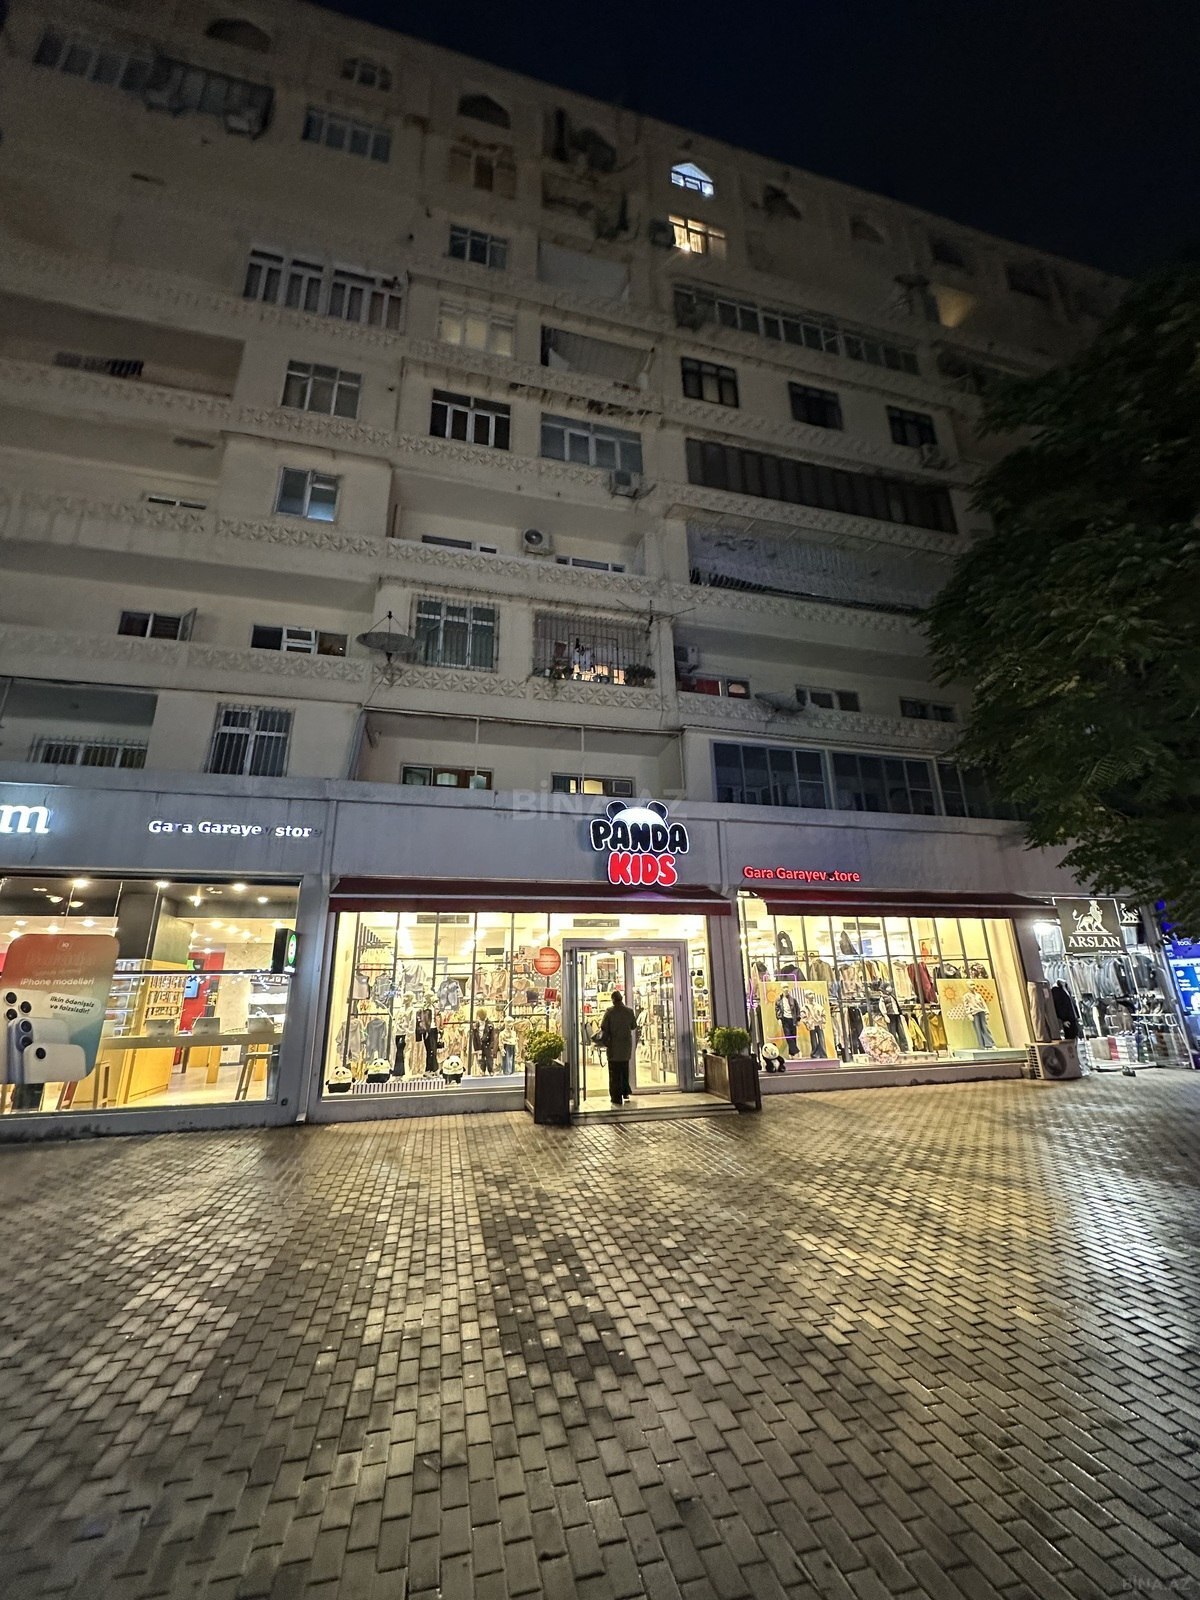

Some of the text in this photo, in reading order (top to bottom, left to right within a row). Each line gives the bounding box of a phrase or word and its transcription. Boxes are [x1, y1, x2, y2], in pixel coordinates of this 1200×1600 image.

[148, 820, 193, 833] Gara
[590, 819, 690, 854] PANDA
[608, 852, 678, 887] KIDS
[743, 866, 774, 879] Gara
[776, 867, 827, 882] Garayev
[1068, 936, 1121, 948] ARSLAN
[20, 978, 50, 986] iPhone
